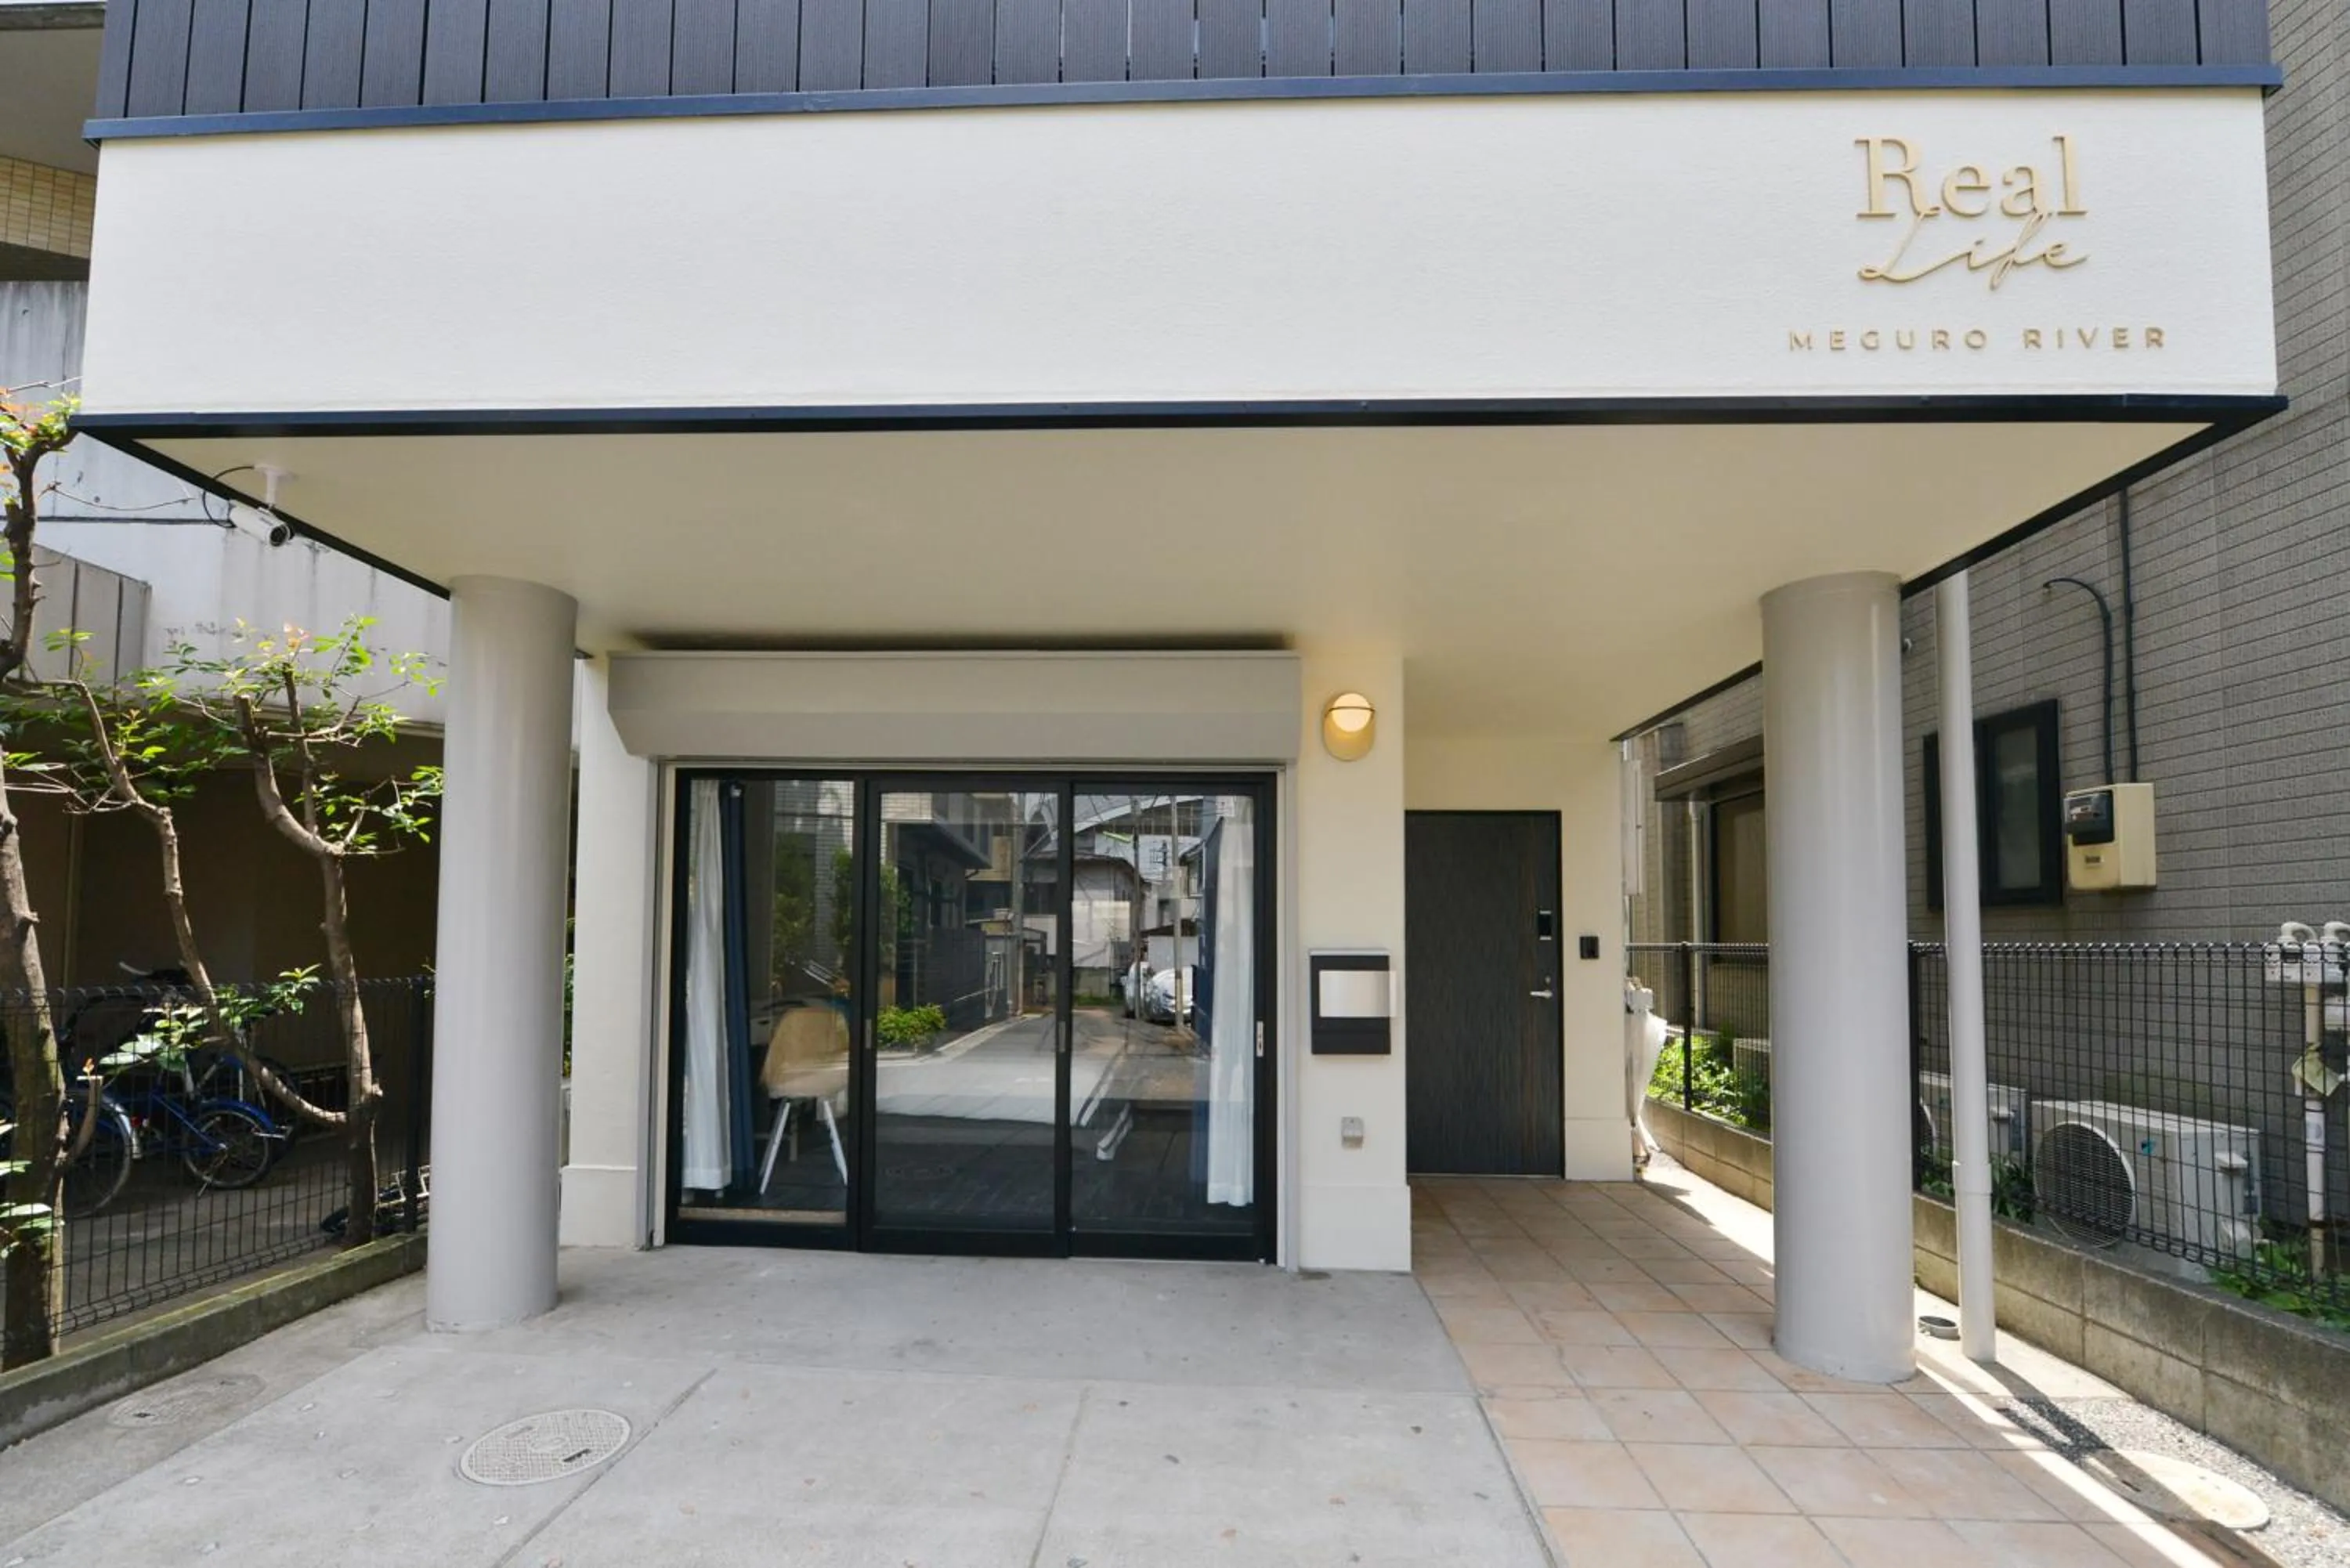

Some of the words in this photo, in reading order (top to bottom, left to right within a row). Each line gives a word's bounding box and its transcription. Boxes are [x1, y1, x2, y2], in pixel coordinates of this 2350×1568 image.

[1854, 135, 2088, 218] Real
[1857, 208, 2090, 291] Life
[1789, 330, 1988, 352] MEGURO
[2023, 327, 2166, 349] RIVER
